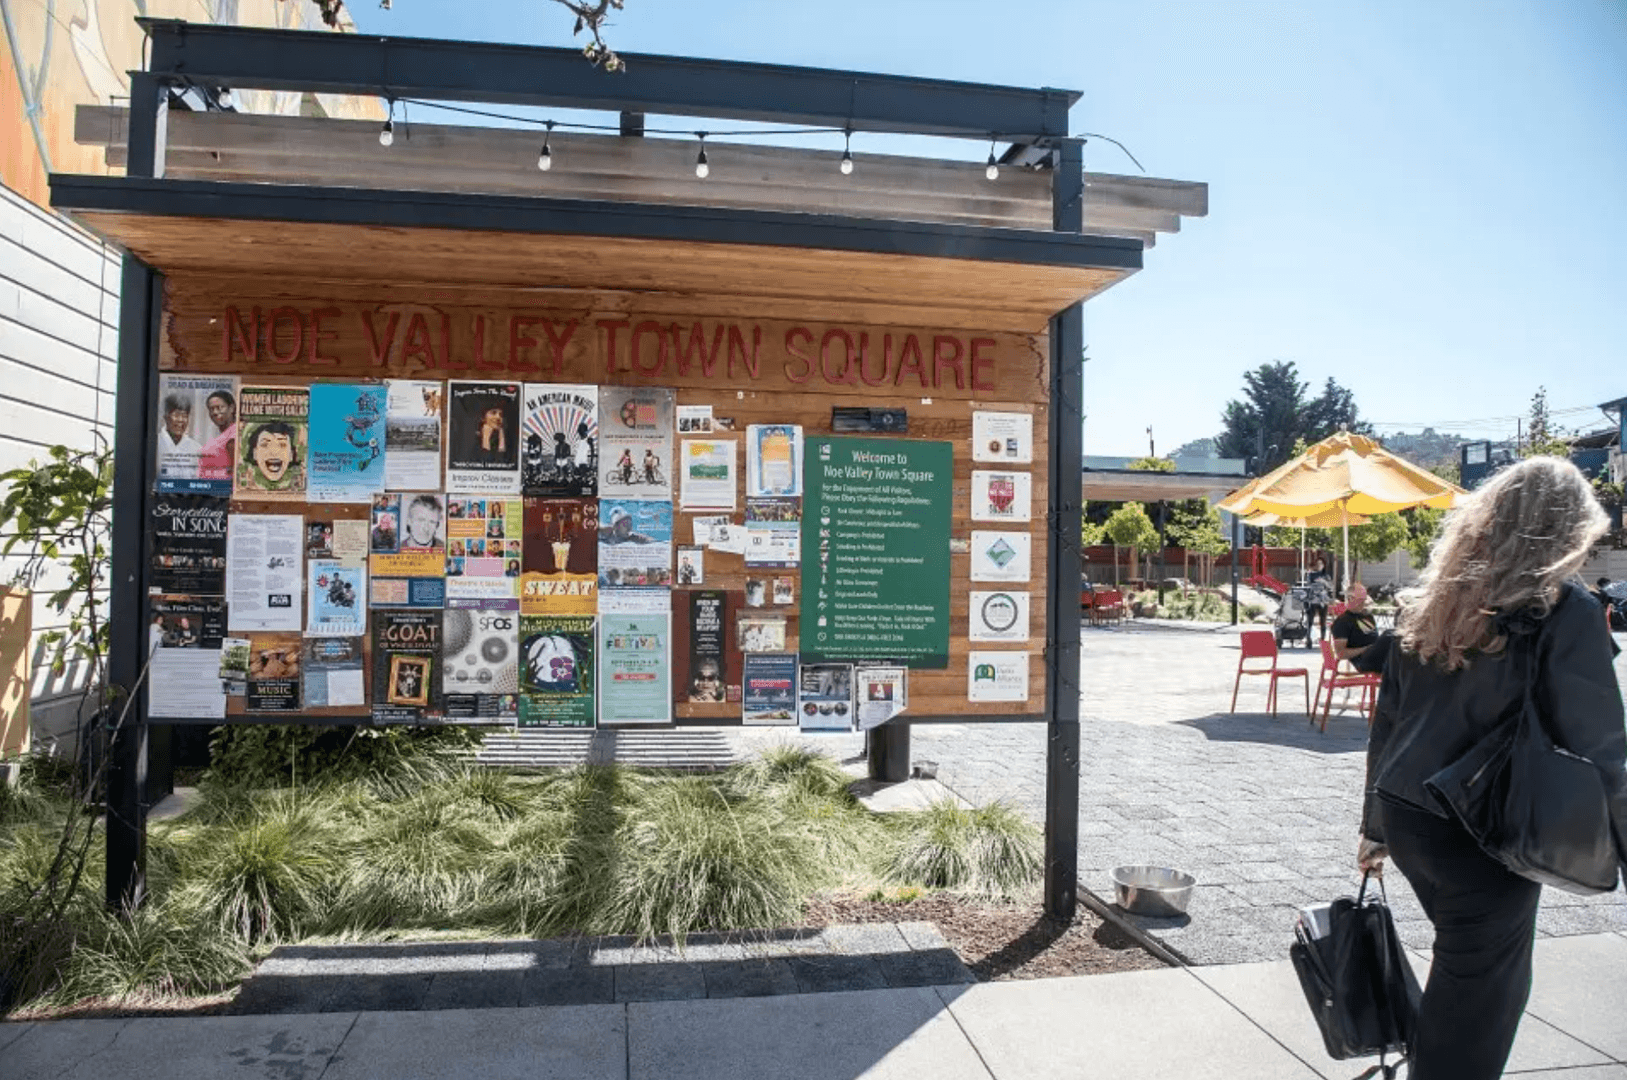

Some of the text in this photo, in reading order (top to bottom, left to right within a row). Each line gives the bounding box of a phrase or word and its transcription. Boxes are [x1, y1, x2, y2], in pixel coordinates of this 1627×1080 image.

[222, 304, 996, 391] NOE VALLEY TOWN SQUARE
[241, 394, 271, 404] WOMEN
[526, 399, 538, 411] AN
[538, 392, 571, 406] AMERICAN
[241, 404, 265, 415] ALONE
[266, 405, 284, 415] WITH
[852, 450, 907, 465] Welcome to
[452, 473, 514, 483] Improv Classes
[824, 465, 934, 483] Noe Valley Town Square
[152, 503, 224, 518] Storytelling
[172, 517, 227, 532] IN SONG
[524, 580, 595, 595] SWEAT
[480, 618, 512, 631] SFOS
[387, 624, 438, 641] GOAT
[606, 636, 662, 650] FESTIVAL
[258, 686, 291, 694] MUSIC
